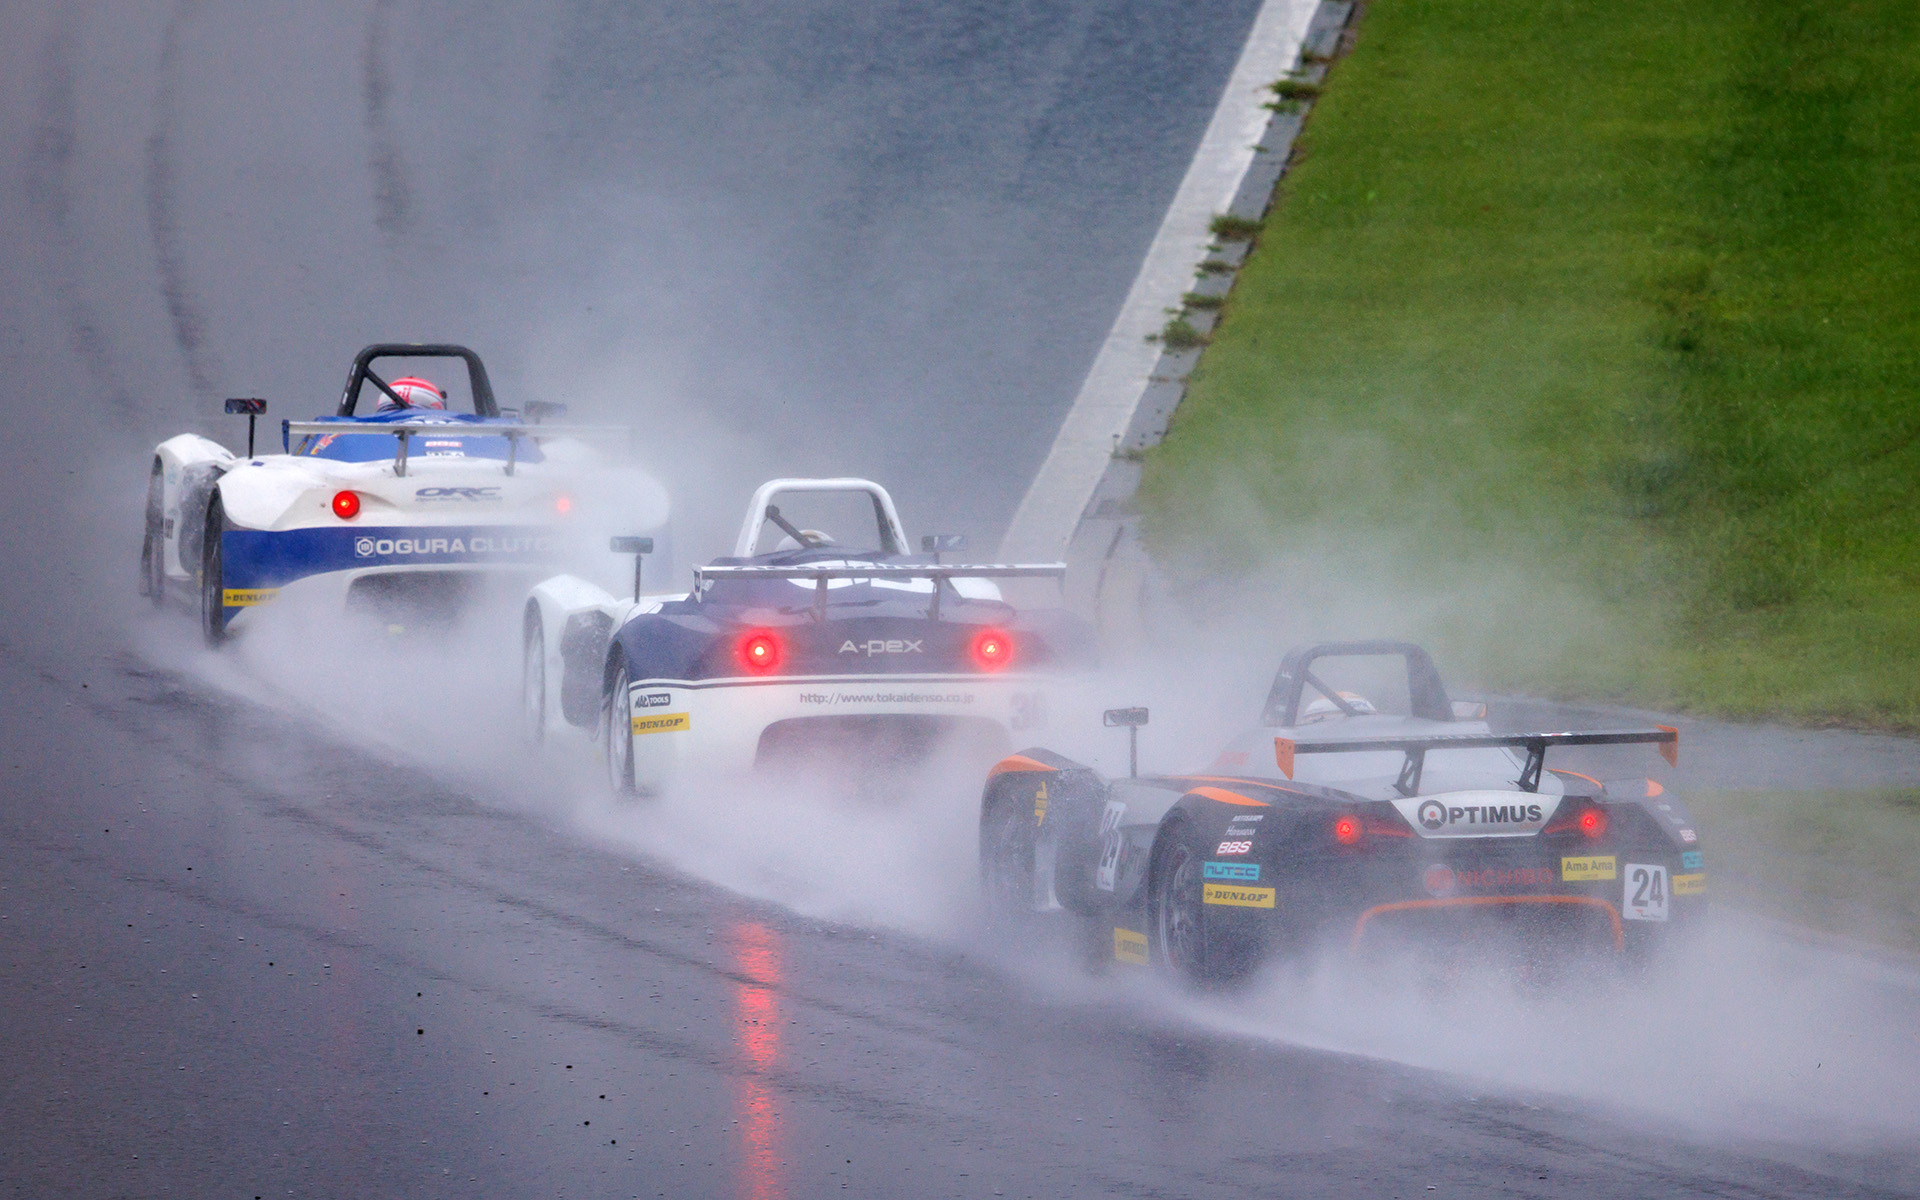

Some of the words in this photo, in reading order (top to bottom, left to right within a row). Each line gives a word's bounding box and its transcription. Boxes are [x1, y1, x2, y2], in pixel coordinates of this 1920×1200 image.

[415, 486, 502, 501] ORC
[376, 537, 466, 555] OGURA
[470, 537, 552, 554] CLUTC
[232, 593, 277, 603] DUNLOP
[838, 638, 924, 658] A-pex
[649, 694, 670, 706] TOOLS
[799, 692, 975, 706] http://www.tokaidenso.co.jp
[639, 717, 685, 730] DUNLOP
[1216, 840, 1253, 856] BBS
[1205, 864, 1258, 878] NUTEC
[1564, 859, 1588, 873] Ama
[1590, 858, 1614, 872] Ama
[1630, 867, 1665, 909] 24
[1213, 890, 1269, 903] DUNLOP
